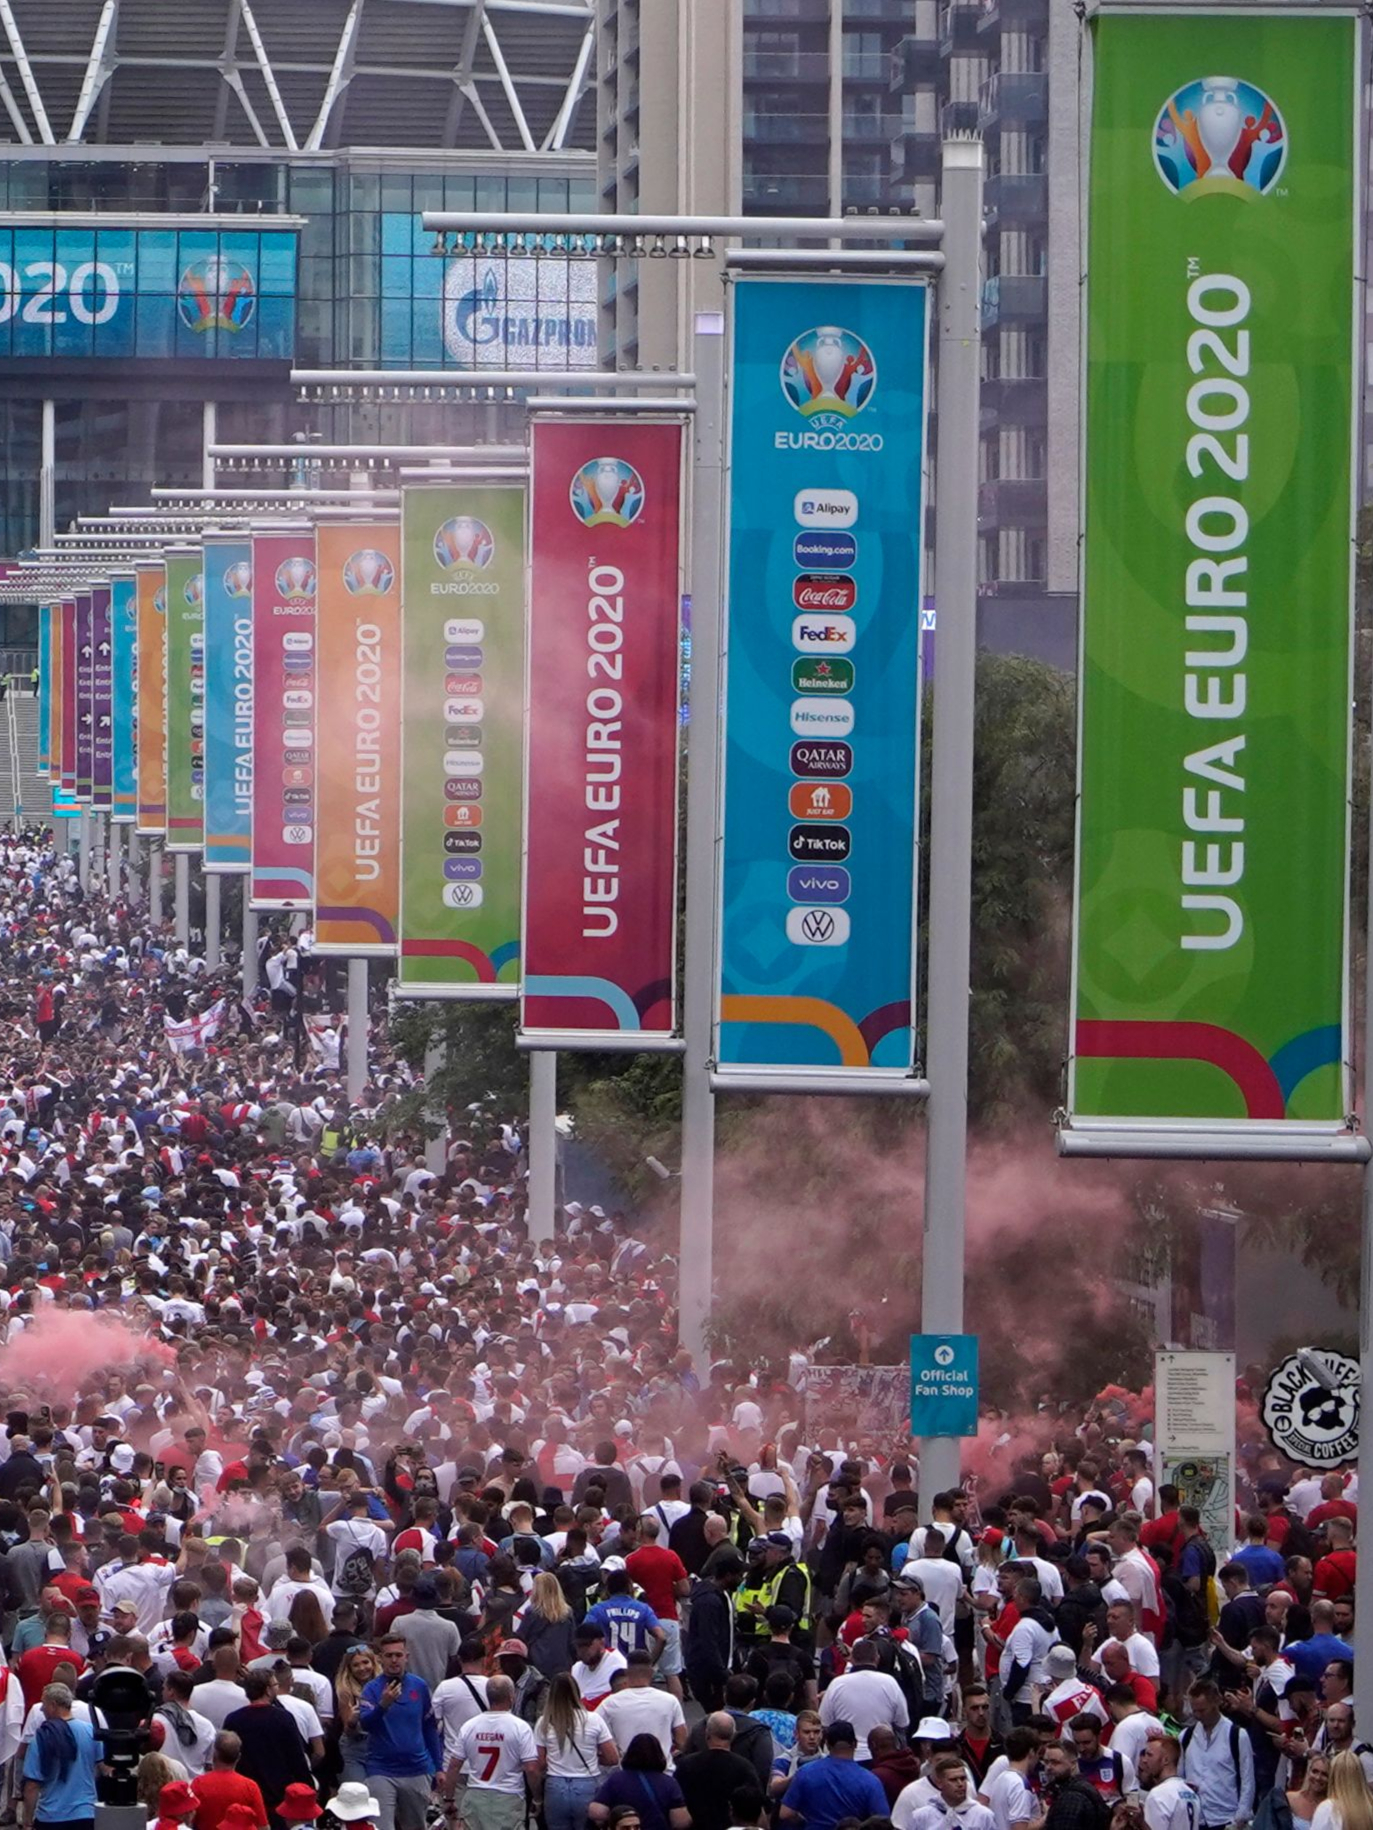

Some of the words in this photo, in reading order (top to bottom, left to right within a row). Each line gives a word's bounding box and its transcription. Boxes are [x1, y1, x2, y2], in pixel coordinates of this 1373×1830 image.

[1184, 273, 1251, 480] 2020
[811, 415, 845, 430] UEFA
[774, 431, 884, 451] EURO2020
[816, 502, 851, 515] Alipay
[796, 544, 854, 556] Booking.com
[1184, 496, 1250, 719] EURO
[586, 565, 625, 680] 2020
[799, 626, 847, 642] FedEx
[234, 618, 253, 679] 2020
[356, 623, 382, 702] 2020
[798, 677, 848, 689] Heineken
[448, 705, 478, 715] FedEx
[795, 712, 850, 723] Hisense
[355, 708, 381, 793] EURO
[585, 688, 624, 811] EURO
[796, 748, 846, 763] QATAR
[808, 761, 846, 770] AIRWAYS
[447, 783, 479, 791] QATAR
[355, 798, 380, 880] UEFA
[807, 838, 846, 850] TikTok
[1180, 735, 1246, 951] UEFA
[450, 864, 476, 872] vivo
[582, 818, 620, 938] UEFA
[799, 877, 839, 890] vivo
[920, 1370, 968, 1381] Official
[915, 1385, 938, 1395] Fan
[942, 1385, 974, 1398] Shop
[1271, 1364, 1313, 1413] BLACK
[1313, 1433, 1358, 1458] COFFEE
[609, 1621, 636, 1653] 14
[478, 1746, 501, 1782] 7
